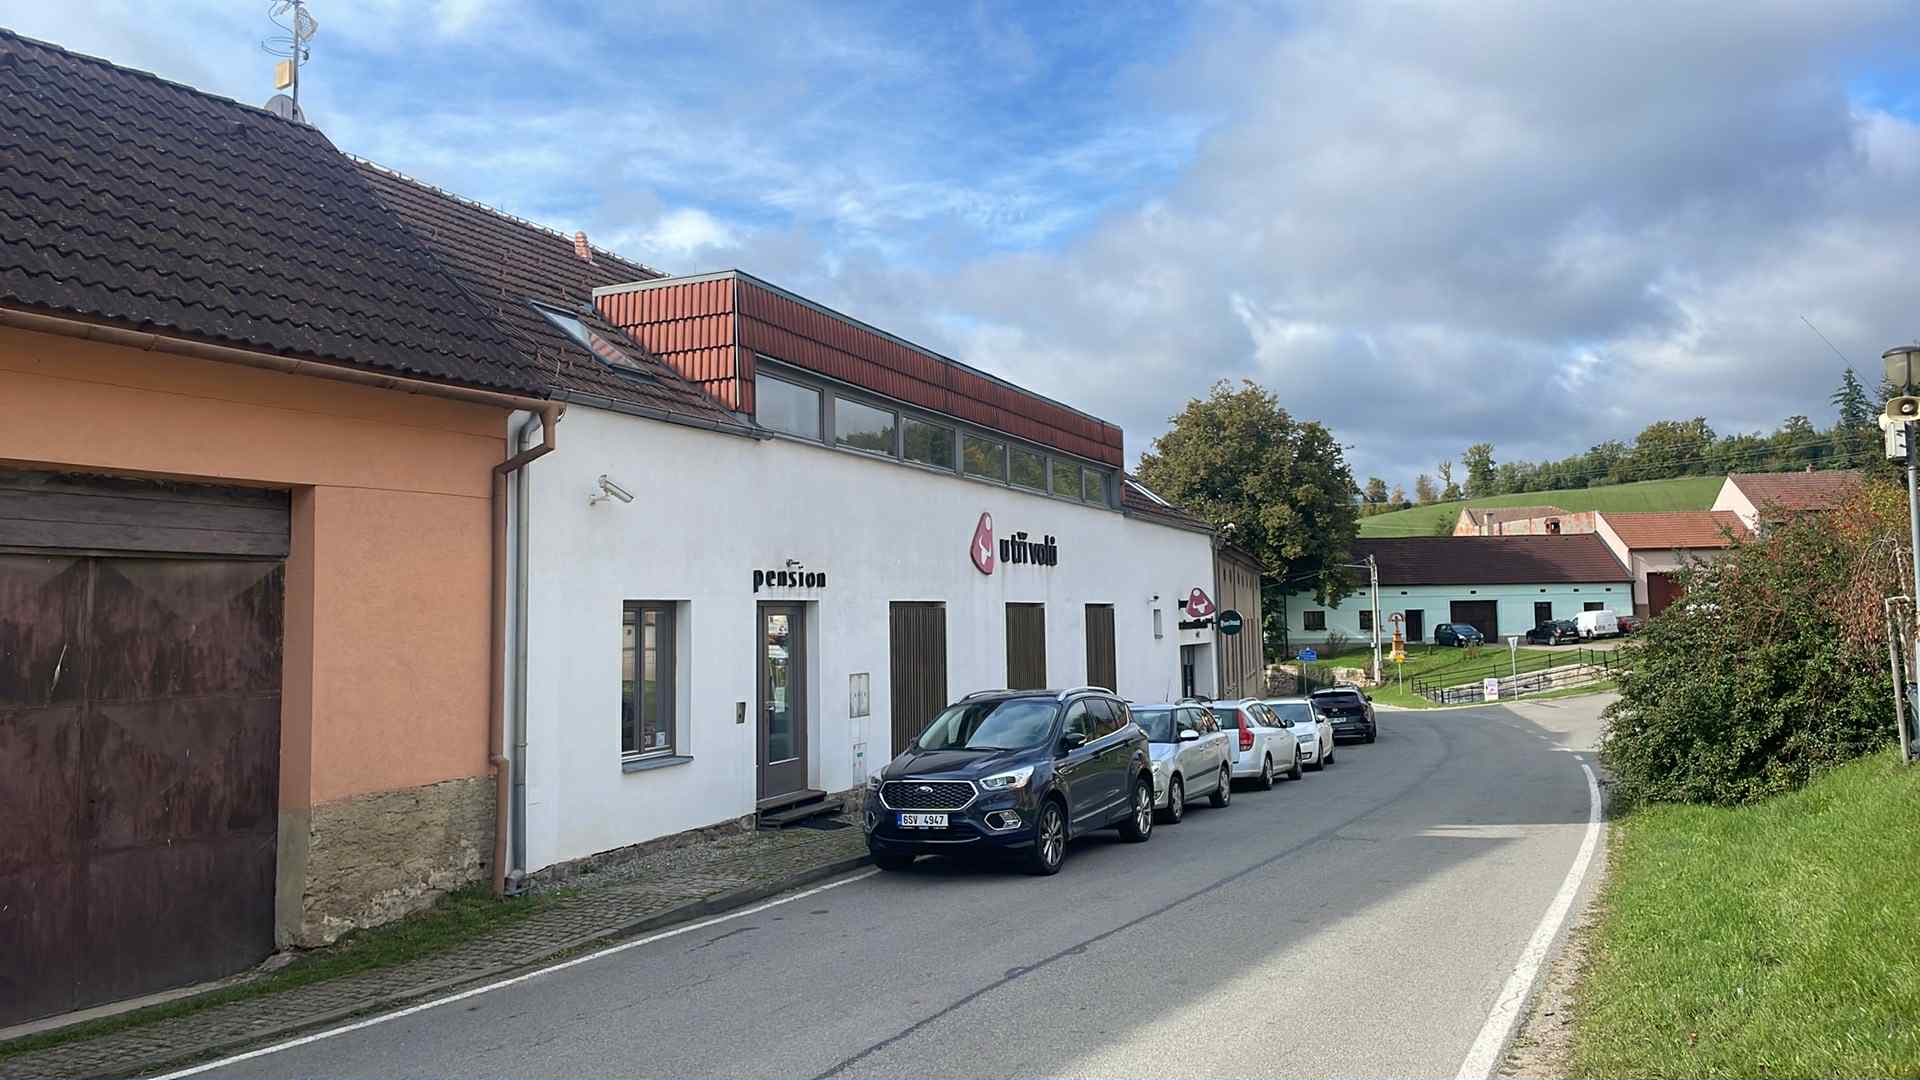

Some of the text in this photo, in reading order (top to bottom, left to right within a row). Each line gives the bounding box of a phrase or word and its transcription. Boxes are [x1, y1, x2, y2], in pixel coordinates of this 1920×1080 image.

[753, 566, 826, 593] pension
[903, 815, 944, 825] 6SV 4947
